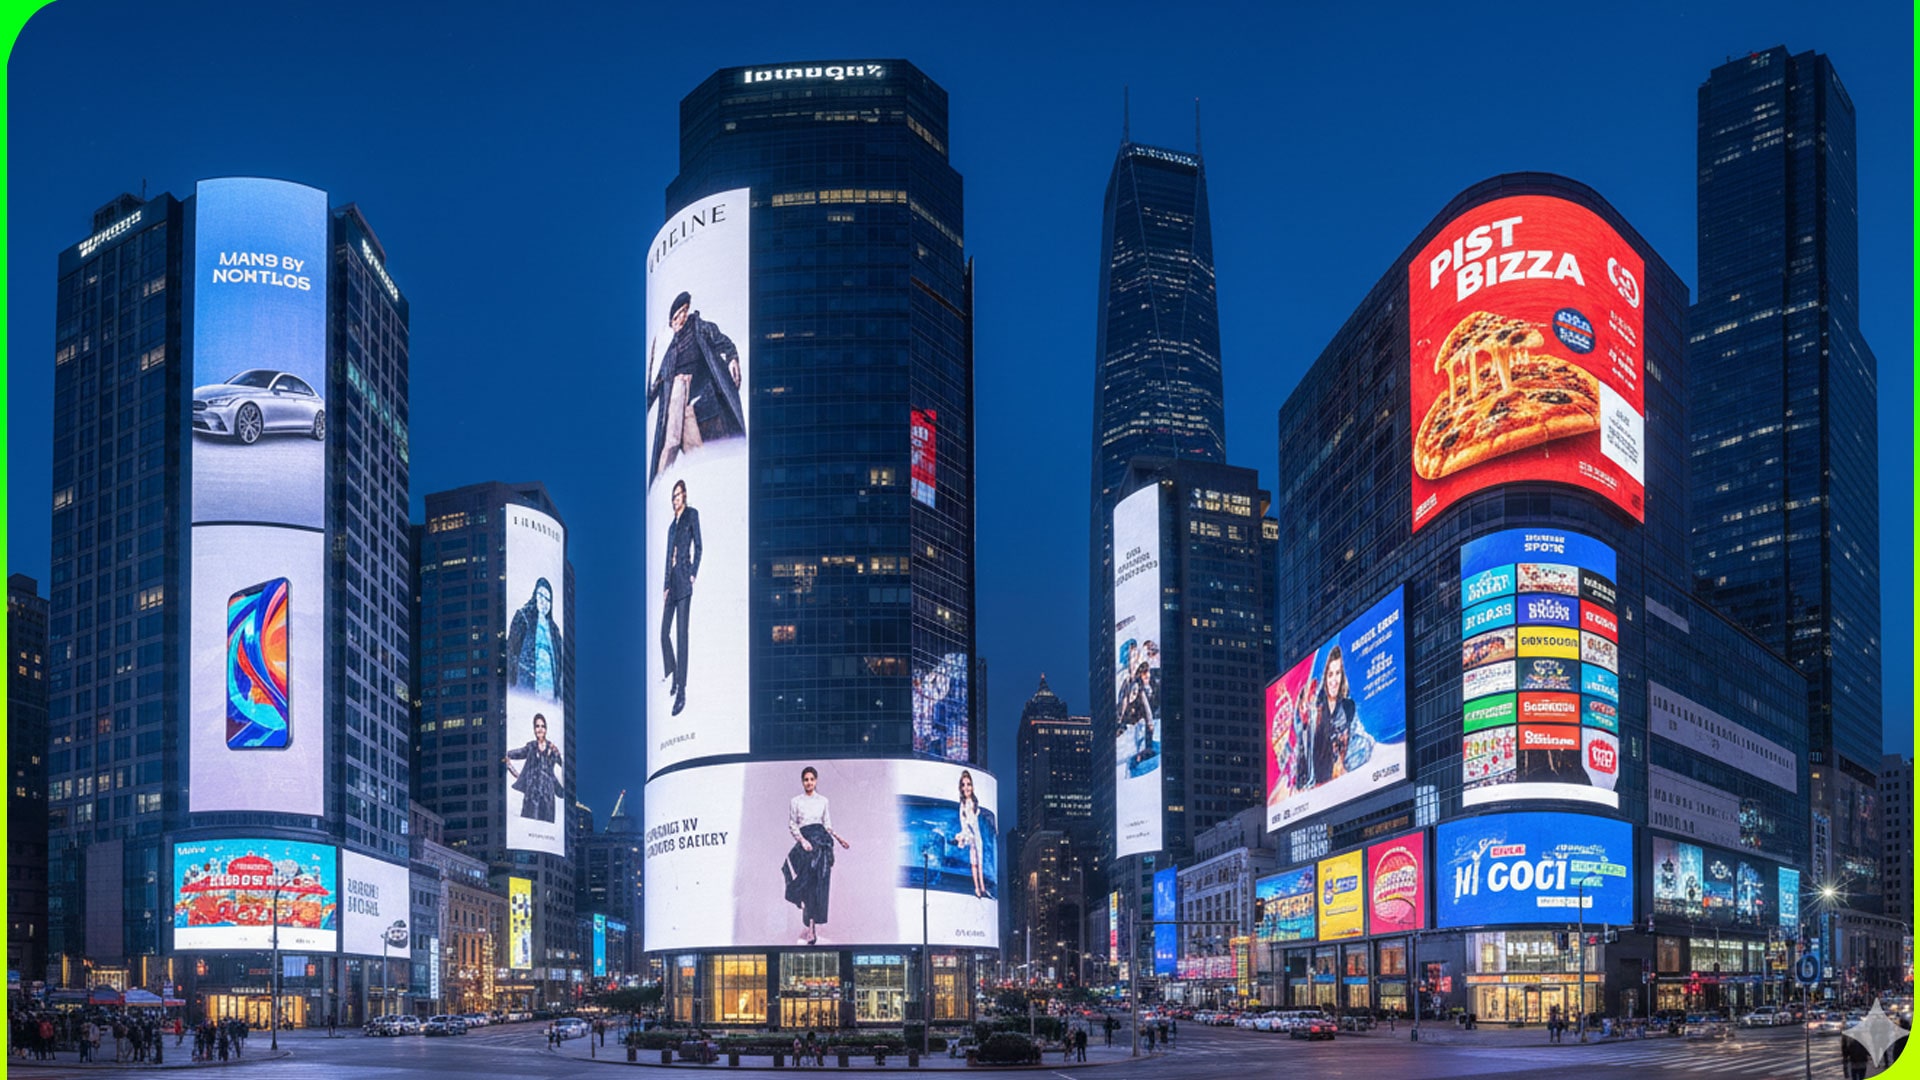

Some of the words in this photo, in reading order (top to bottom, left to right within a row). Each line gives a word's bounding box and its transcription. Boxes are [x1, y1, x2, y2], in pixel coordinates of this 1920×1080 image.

[282, 256, 304, 272] BY
[1430, 216, 1523, 290] PIST
[1457, 250, 1585, 302] BIZZA
